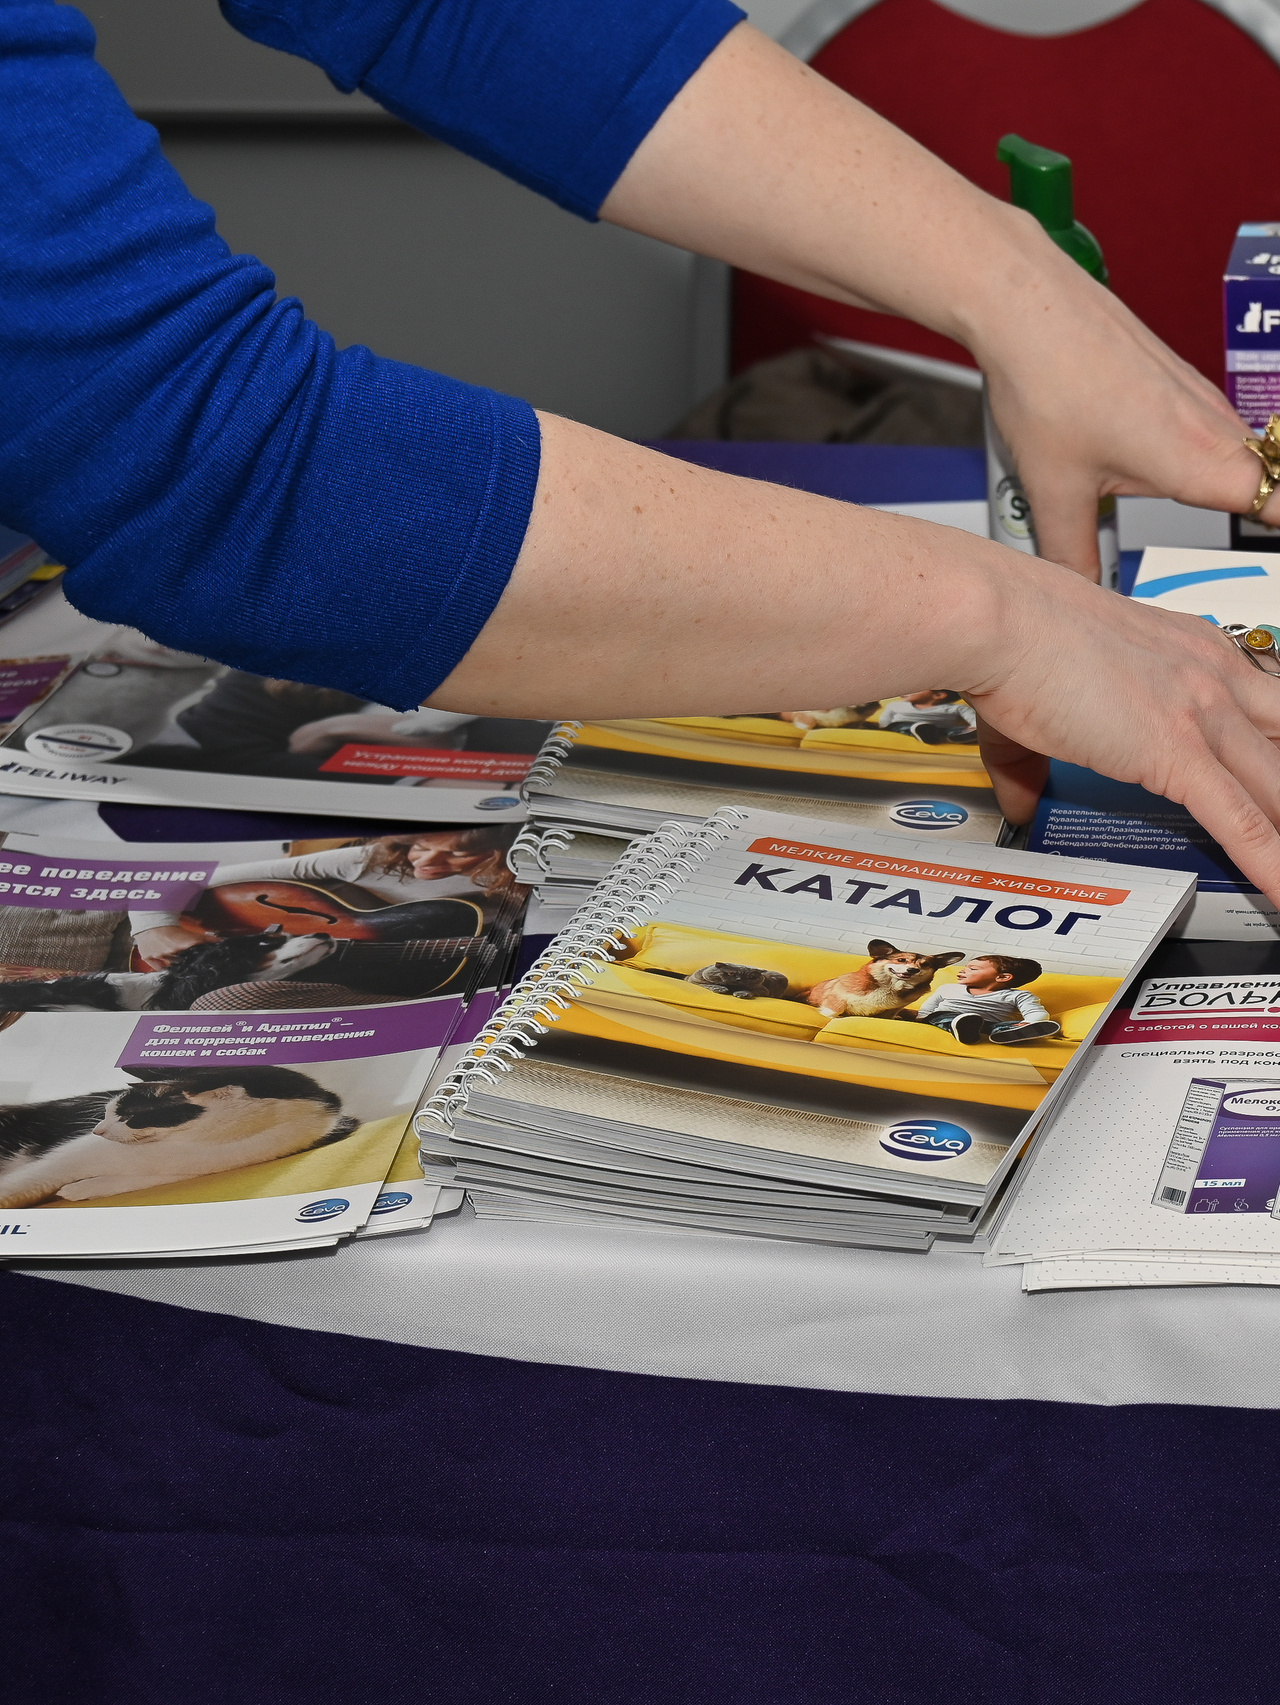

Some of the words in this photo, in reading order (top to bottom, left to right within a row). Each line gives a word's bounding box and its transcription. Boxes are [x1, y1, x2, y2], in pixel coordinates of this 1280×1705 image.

[13, 765, 127, 785] FELIWAY
[40, 866, 207, 883] поведение
[768, 843, 854, 865] МЕЛКИЕ
[857, 857, 983, 884] ДОМАШНИЕ
[988, 876, 1108, 901] ЖИВОТНЫЕ
[70, 888, 162, 901] здесь
[734, 862, 1102, 936] КАТАЛОГ
[1137, 1023, 1195, 1032] заботой
[1211, 1022, 1258, 1030] вашей
[144, 1036, 180, 1047] для
[184, 1034, 277, 1047] коррекции
[281, 1029, 376, 1043] поведения
[140, 1048, 197, 1057] кошек
[216, 1047, 267, 1057] собак
[1121, 1049, 1215, 1059] Специально
[1220, 1059, 1249, 1067] под
